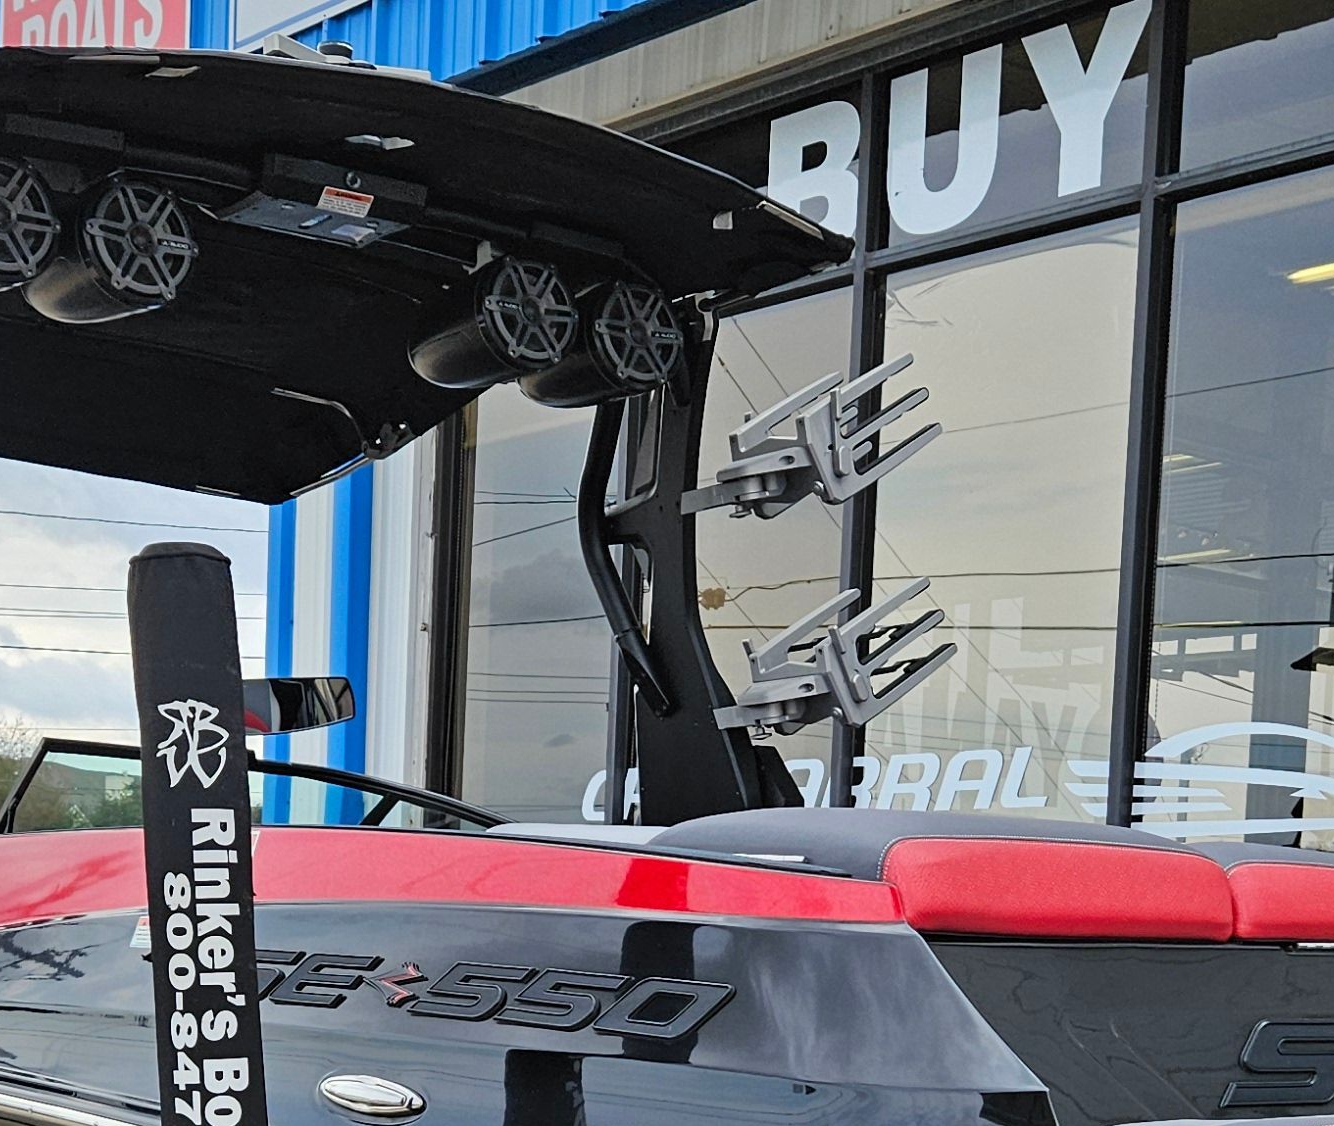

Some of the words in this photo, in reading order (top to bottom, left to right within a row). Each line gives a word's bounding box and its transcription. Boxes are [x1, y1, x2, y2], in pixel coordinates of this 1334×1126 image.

[768, 0, 1151, 236] BUY
[581, 745, 1049, 823] CARAL
[190, 807, 247, 1042] Rinker's
